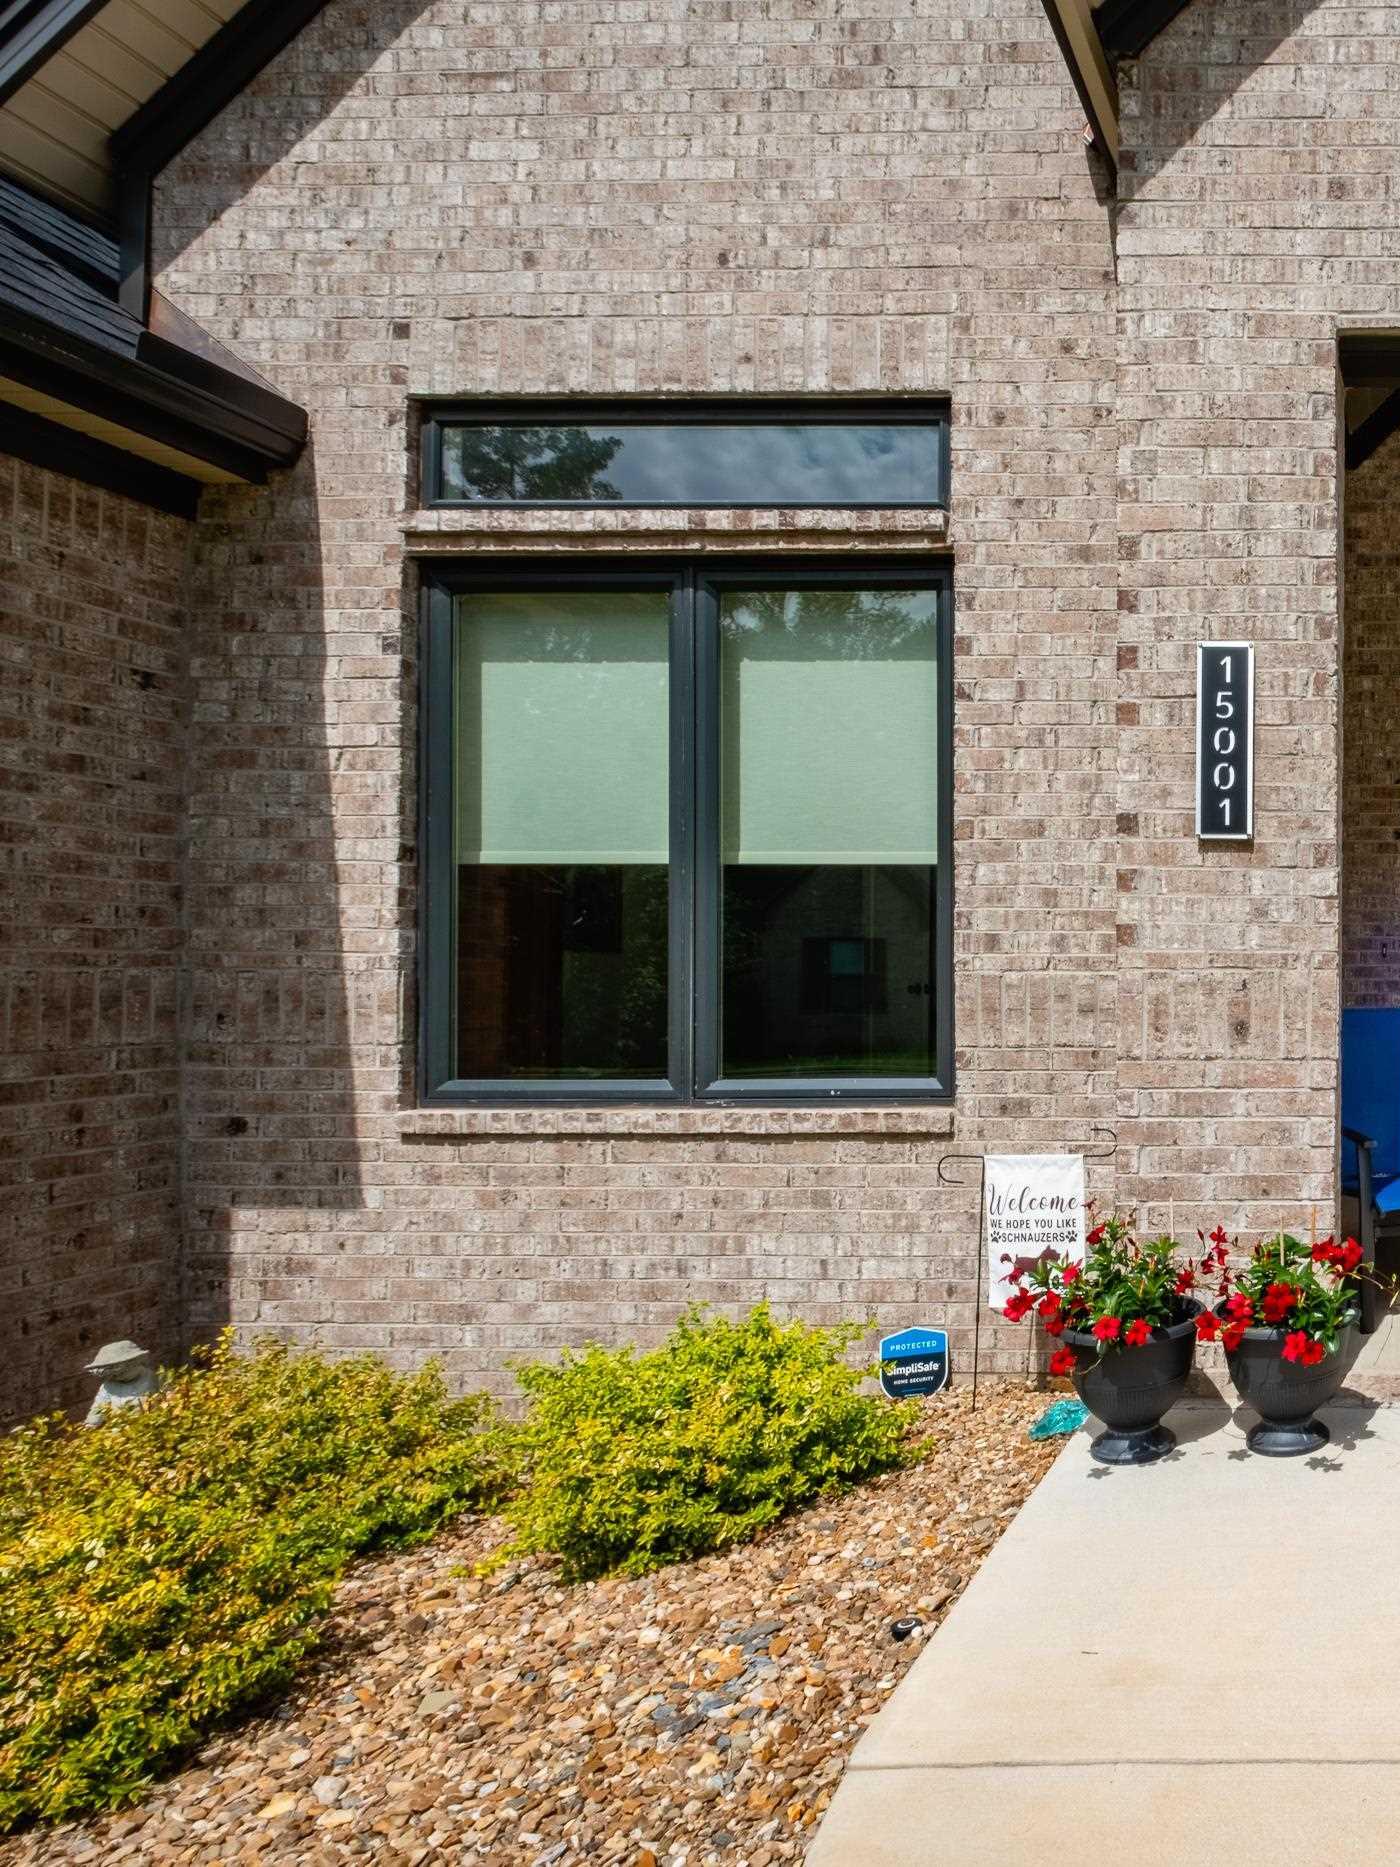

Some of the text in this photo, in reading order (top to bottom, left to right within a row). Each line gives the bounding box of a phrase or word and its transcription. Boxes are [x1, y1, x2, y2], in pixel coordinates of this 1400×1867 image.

[1213, 655, 1236, 827] 15001
[988, 1183, 1079, 1216] Welcome
[990, 1218, 1077, 1229] WE HOPE YOU LIKE
[1001, 1232, 1065, 1243] SCHNAUZERS
[890, 1340, 937, 1351] PROTECTED
[909, 1376, 934, 1384] SECURITY
